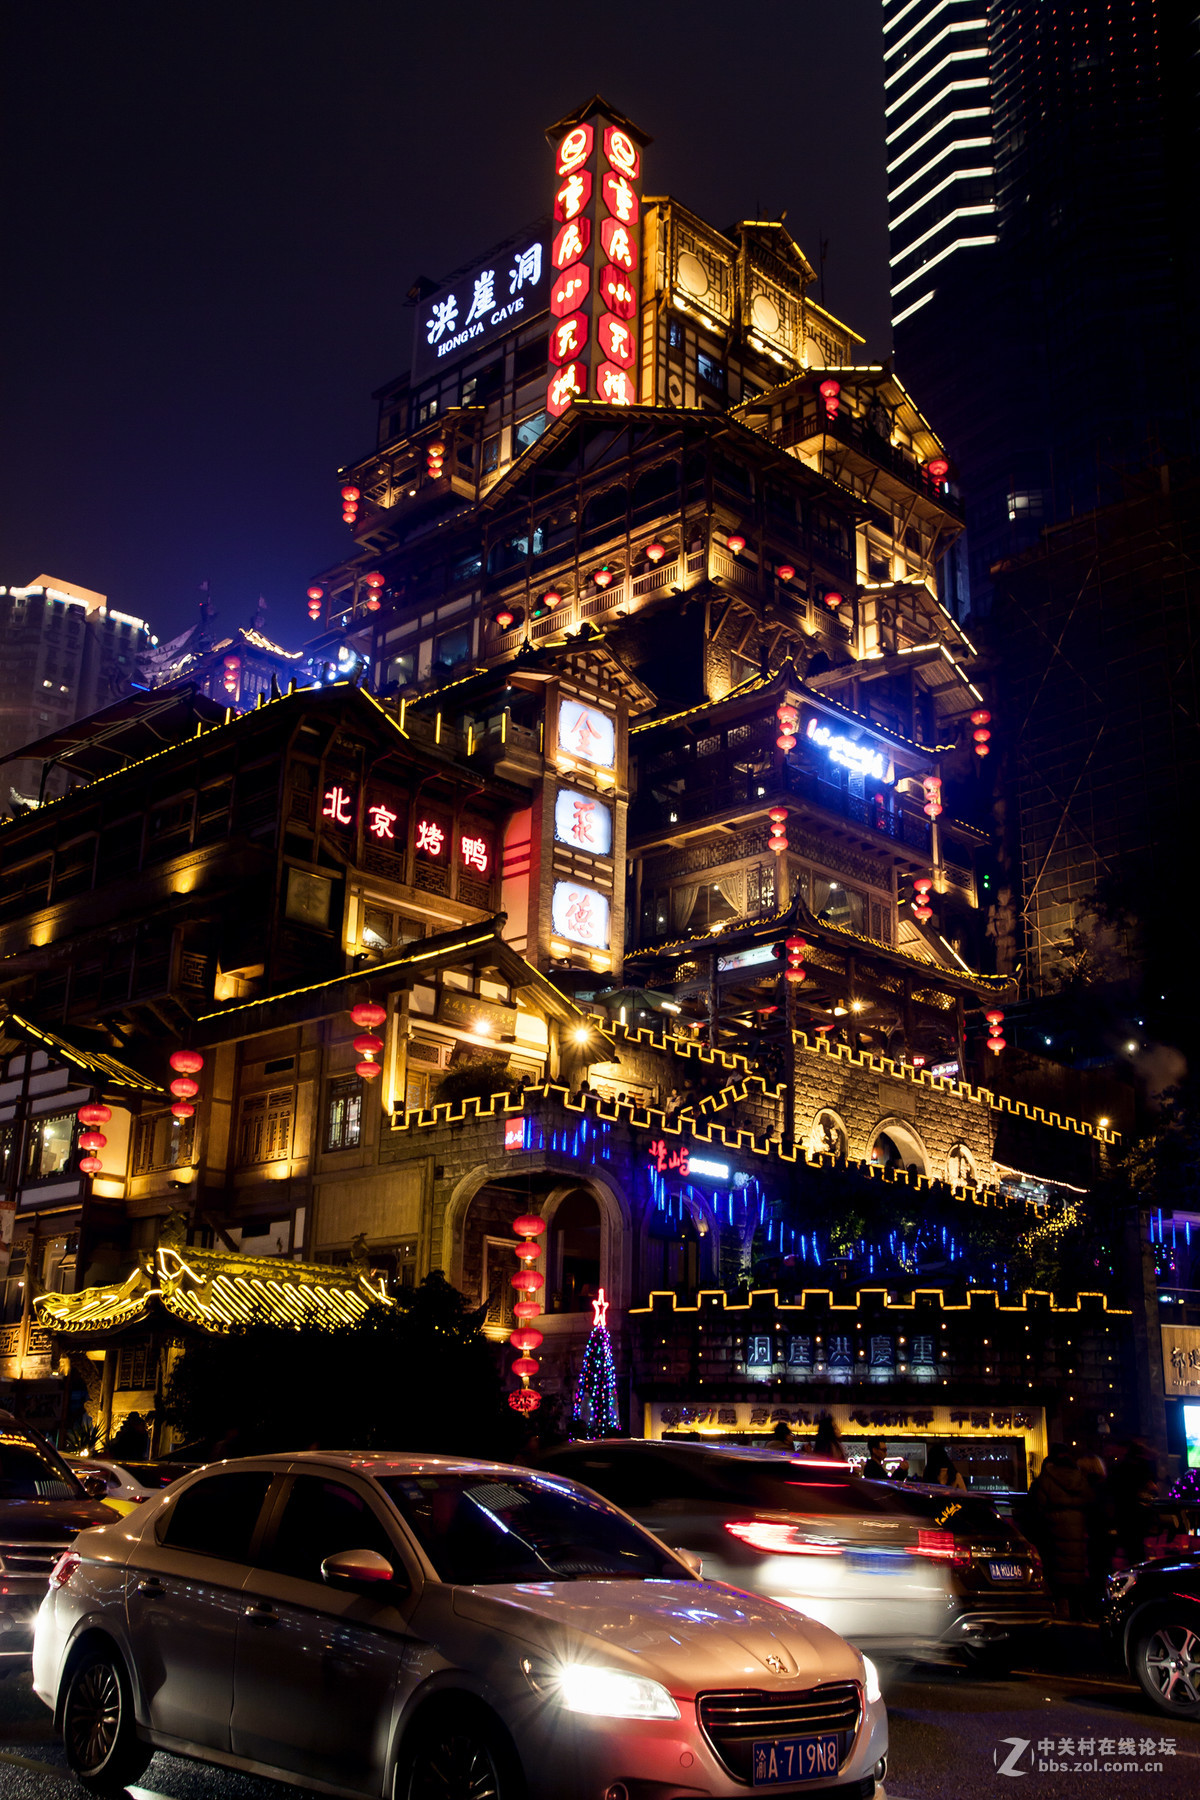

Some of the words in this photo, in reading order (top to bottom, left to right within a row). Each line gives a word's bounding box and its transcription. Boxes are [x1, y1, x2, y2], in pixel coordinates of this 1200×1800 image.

[426, 243, 542, 345] 洪崖洞
[437, 321, 485, 357] HONGYA
[490, 297, 525, 325] CAVE
[322, 787, 488, 872] 北京烤鸭
